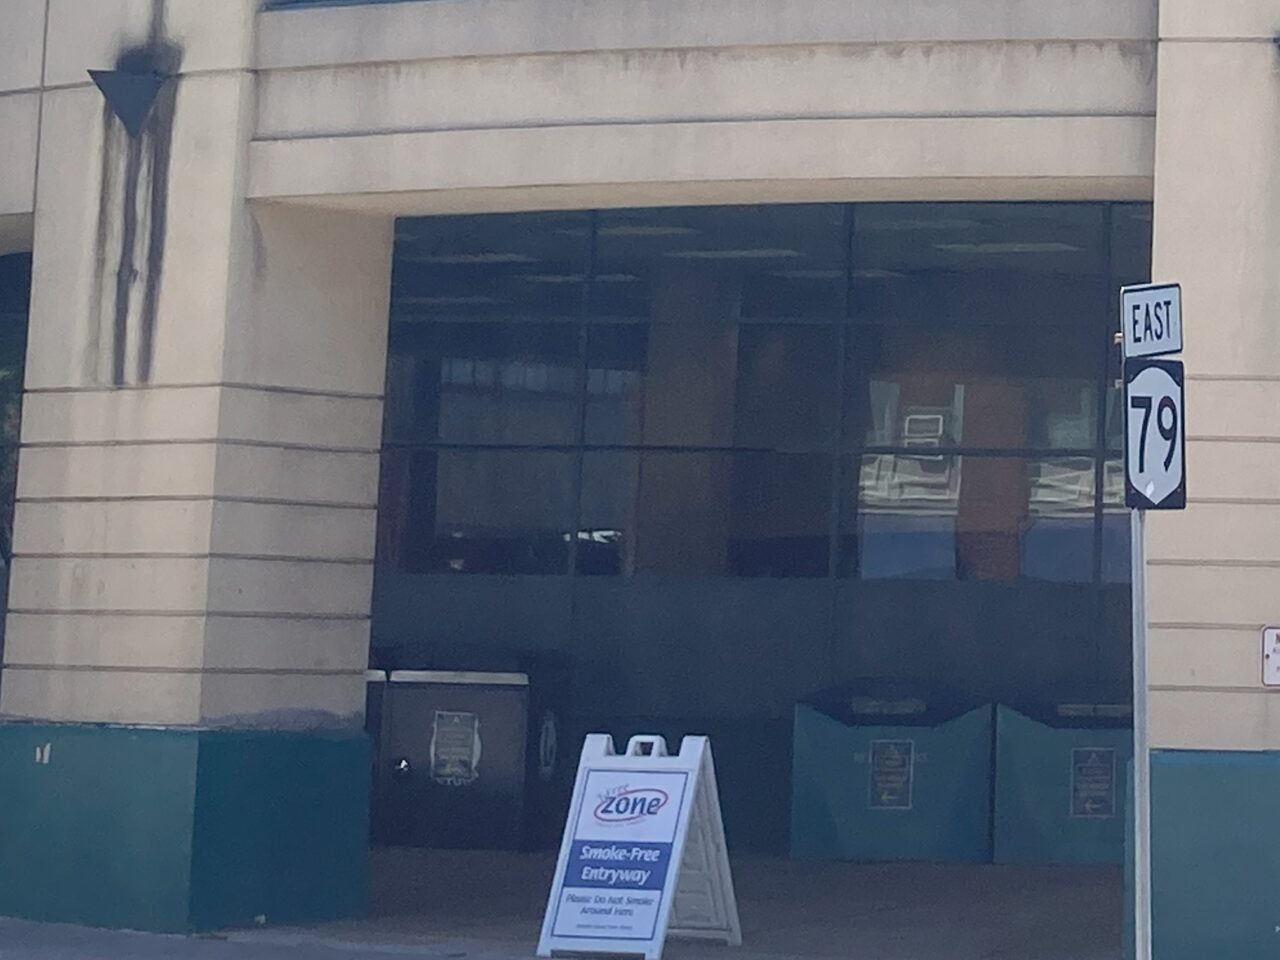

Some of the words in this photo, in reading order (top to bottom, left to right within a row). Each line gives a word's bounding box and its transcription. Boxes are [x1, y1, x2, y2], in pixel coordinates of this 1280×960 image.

[1132, 300, 1172, 343] EAST
[1131, 395, 1178, 473] 79
[600, 796, 662, 816] zone
[579, 844, 661, 862] Smoke-Free
[581, 866, 652, 886] Entryway
